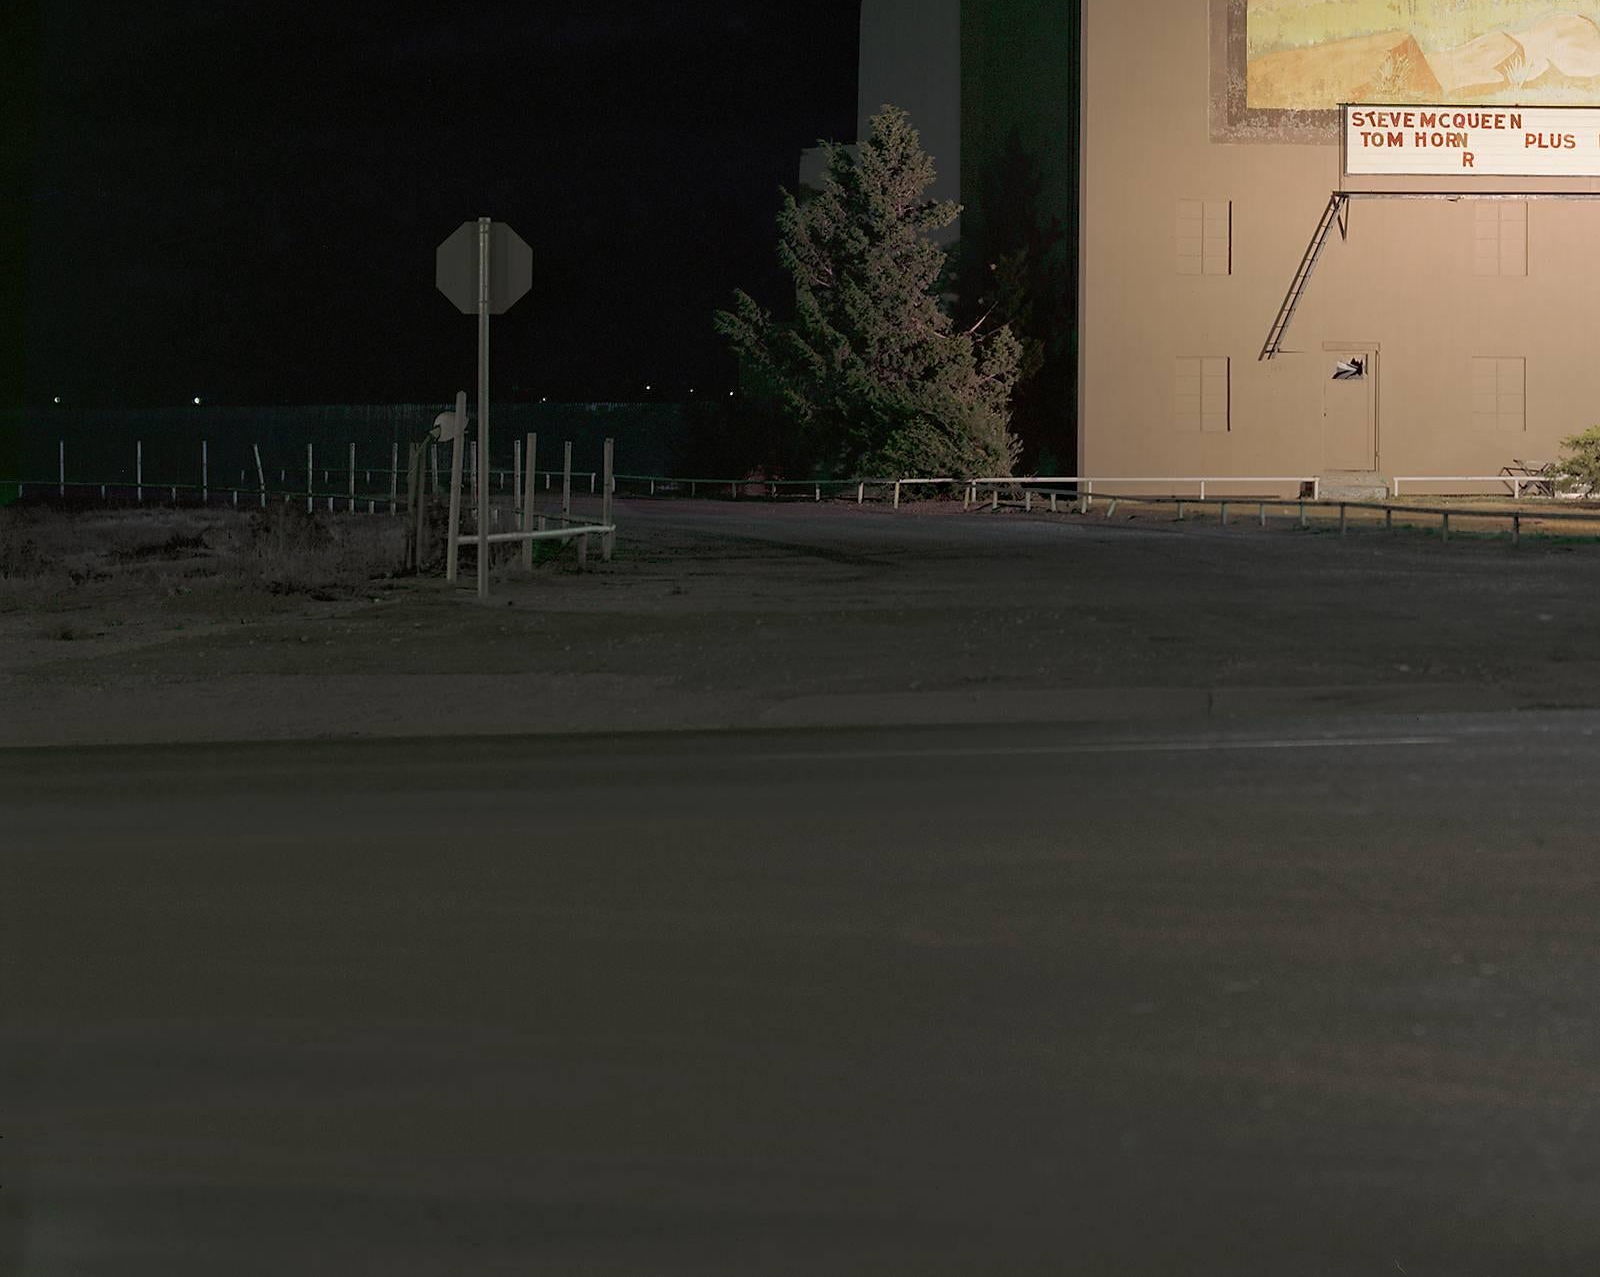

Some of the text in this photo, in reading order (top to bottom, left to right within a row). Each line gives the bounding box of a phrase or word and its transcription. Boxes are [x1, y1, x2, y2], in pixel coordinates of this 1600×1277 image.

[1351, 111, 1522, 129] STEVE MCQUEEN
[1360, 131, 1404, 148] TOM
[1415, 132, 1468, 148] HORN
[1524, 133, 1576, 149] PLUS
[1462, 152, 1474, 167] R
